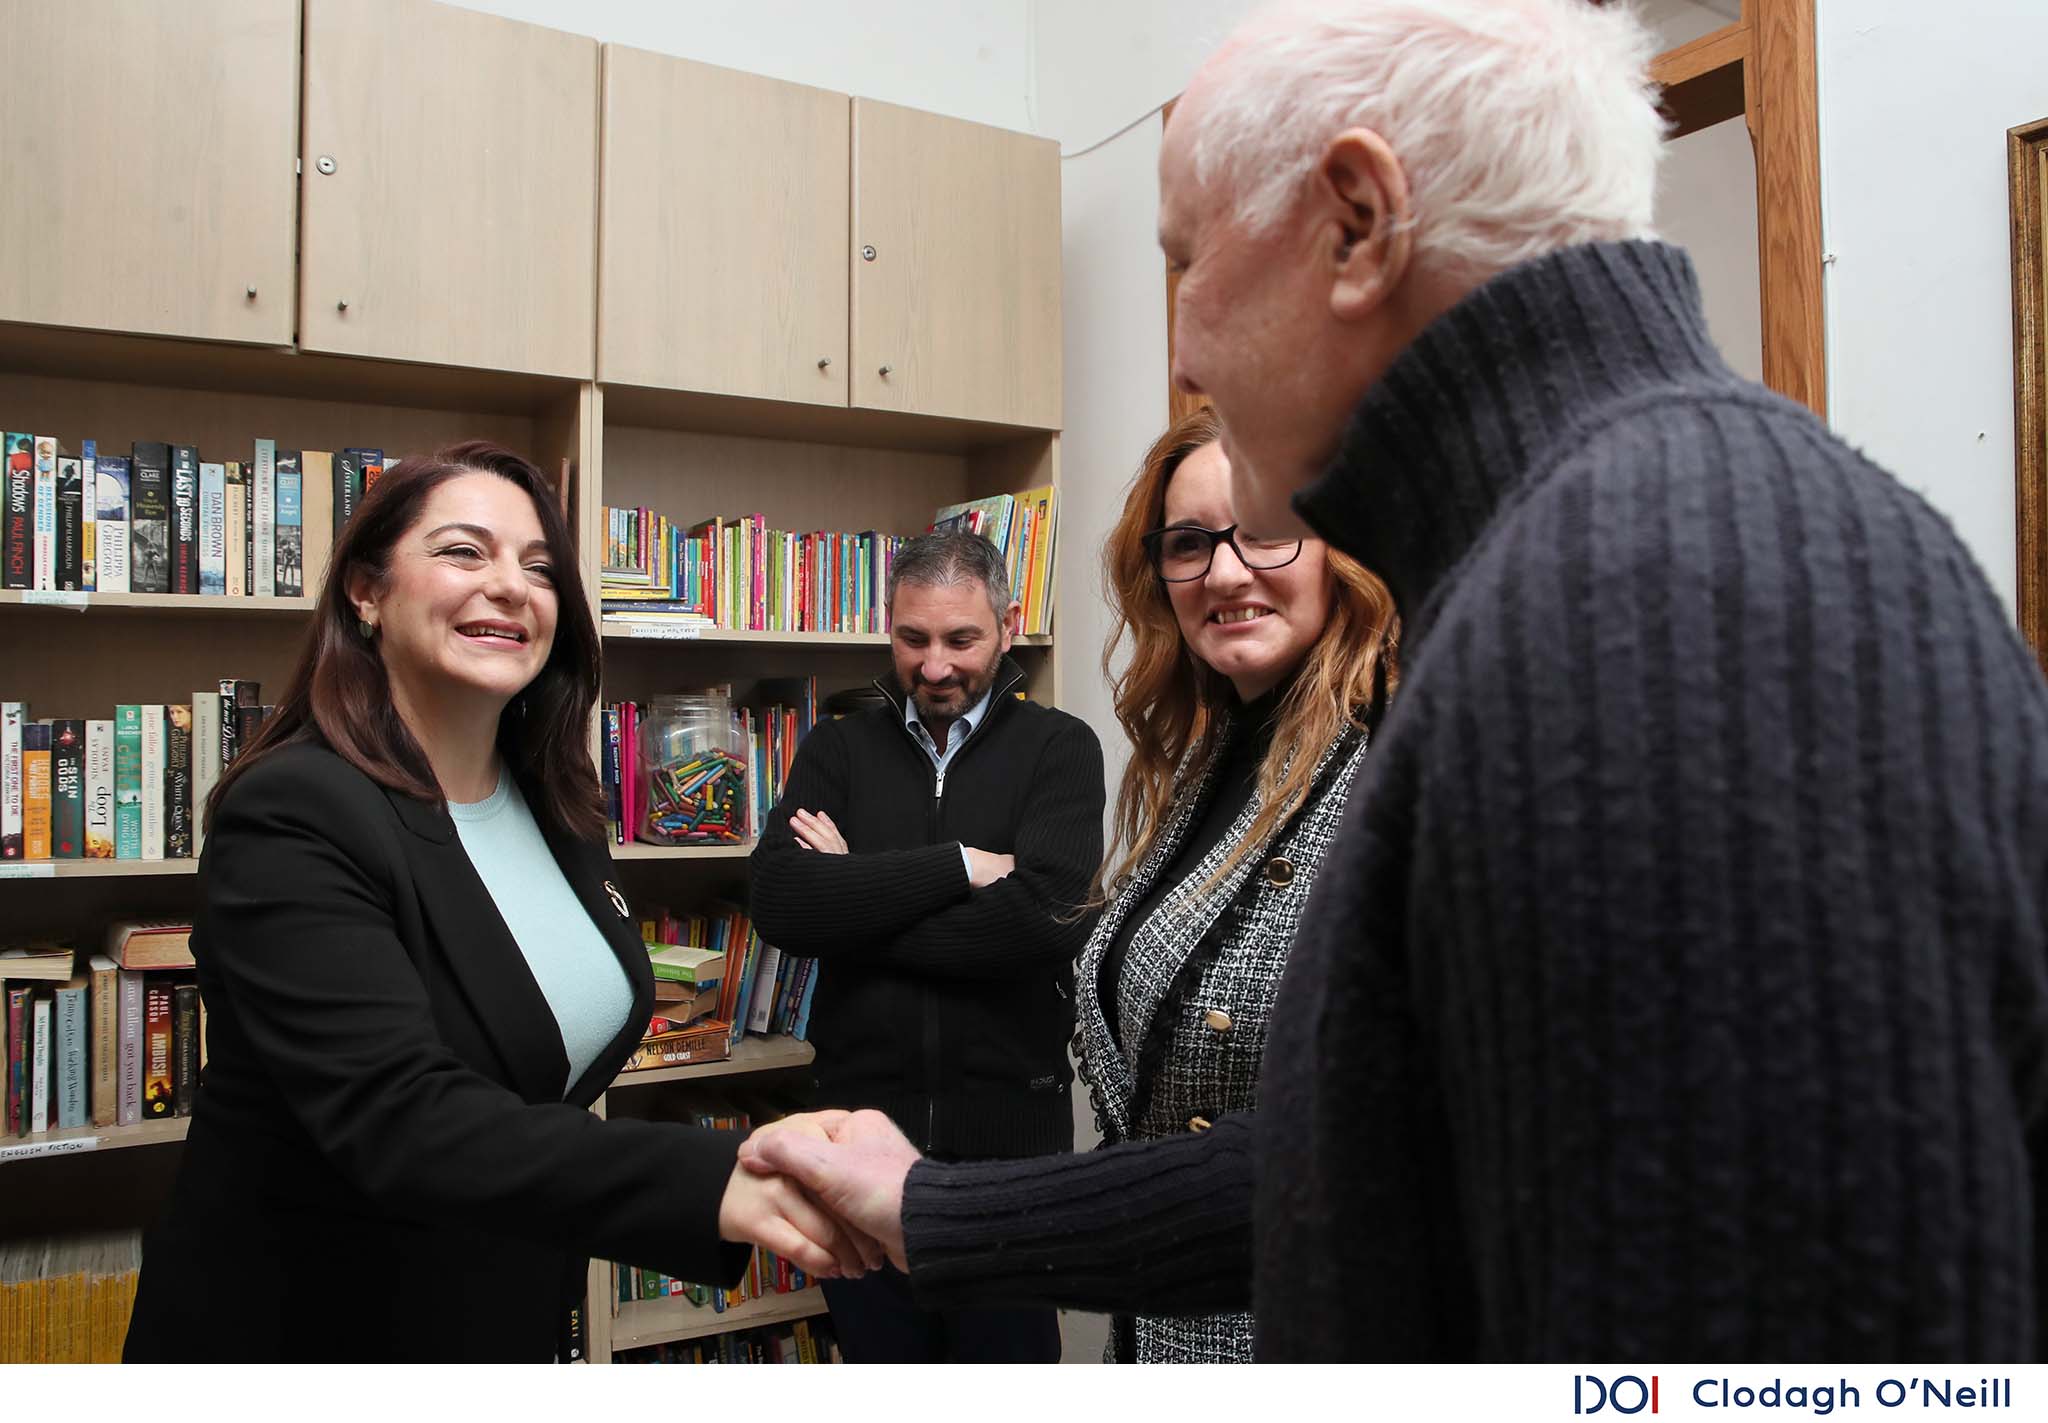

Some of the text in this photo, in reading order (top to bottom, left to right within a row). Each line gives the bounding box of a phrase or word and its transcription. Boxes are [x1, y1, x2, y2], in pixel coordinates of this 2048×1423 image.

[176, 469, 193, 497] LAST
[261, 448, 269, 485] EVERYTHING
[11, 469, 31, 513] Shadows
[37, 485, 44, 495] OF
[176, 497, 192, 507] 10
[261, 497, 269, 513] LEFT
[342, 460, 355, 516] SISTERLAND
[179, 507, 193, 542] SECONDS
[211, 492, 222, 558] DAN BROWN
[261, 514, 269, 536] BEHIND
[11, 517, 25, 575] PAUL FINCH
[103, 524, 114, 578] GREGORY
[113, 528, 125, 577] PHILIPPA
[223, 698, 231, 709] the
[146, 712, 158, 754] jane fallon
[170, 728, 180, 768] GREGORY
[222, 724, 233, 761] Dream
[90, 739, 98, 780] NICHOLAS
[102, 746, 110, 773] EVANS
[117, 744, 129, 791] CHILD
[179, 736, 188, 768] PHILIPPA
[10, 741, 19, 817] THE FIRST ONE TO DIE
[57, 758, 68, 793] GODS
[67, 766, 79, 799] SKIN
[91, 786, 112, 827] Loop
[172, 772, 184, 832] WHITE QUEEN
[120, 813, 129, 856] DYING FOR
[130, 820, 138, 849] WORTH
[65, 993, 78, 1020] Jenny
[126, 1006, 139, 1038] fallon
[148, 989, 159, 1023] CARSON
[159, 995, 169, 1016] PAUL
[151, 1032, 167, 1077] AMBUSH
[646, 1038, 705, 1055] NELSON DEMILLE
[663, 1051, 691, 1062] GOLD COAST
[66, 1049, 80, 1081] Working
[124, 1043, 137, 1107] got you back
[1, 1142, 84, 1158] ENGLISH FICTION
